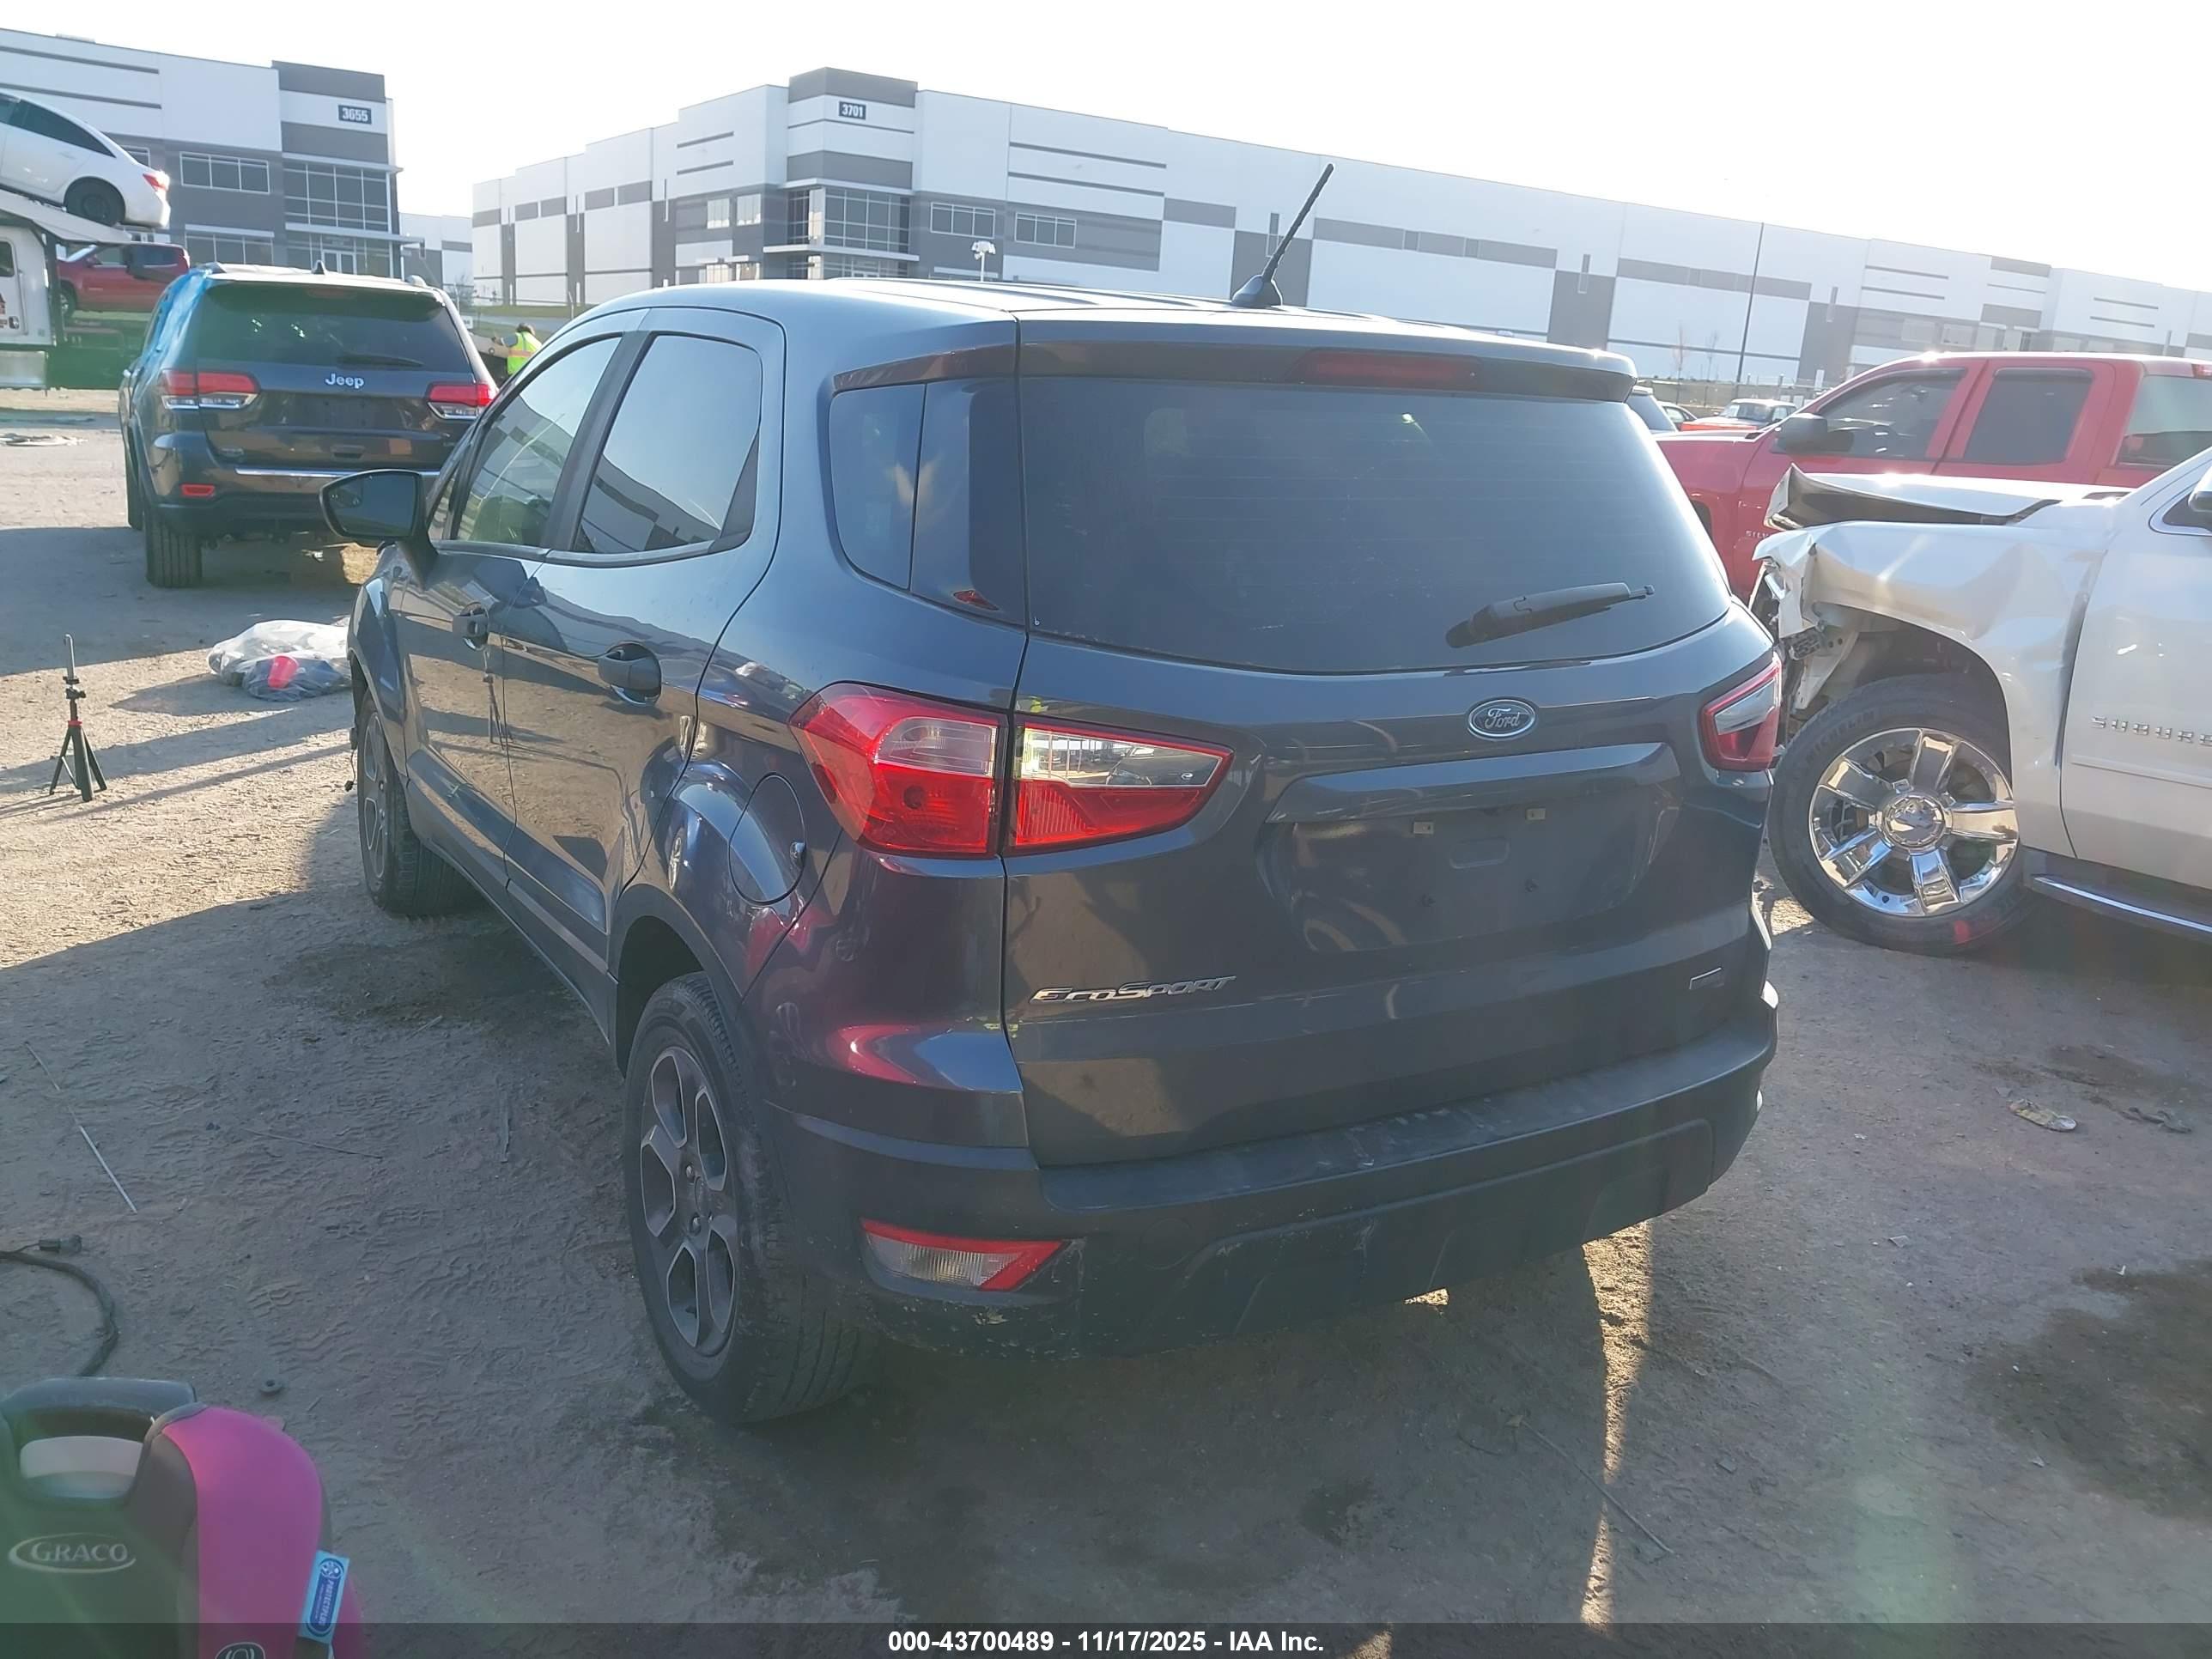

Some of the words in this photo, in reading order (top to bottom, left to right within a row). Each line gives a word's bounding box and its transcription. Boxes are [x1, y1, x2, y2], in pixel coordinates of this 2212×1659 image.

[842, 103, 863, 118] 3701
[325, 373, 364, 389] Jeep
[1484, 707, 1520, 729] Ford
[30, 1541, 129, 1562] GRACO
